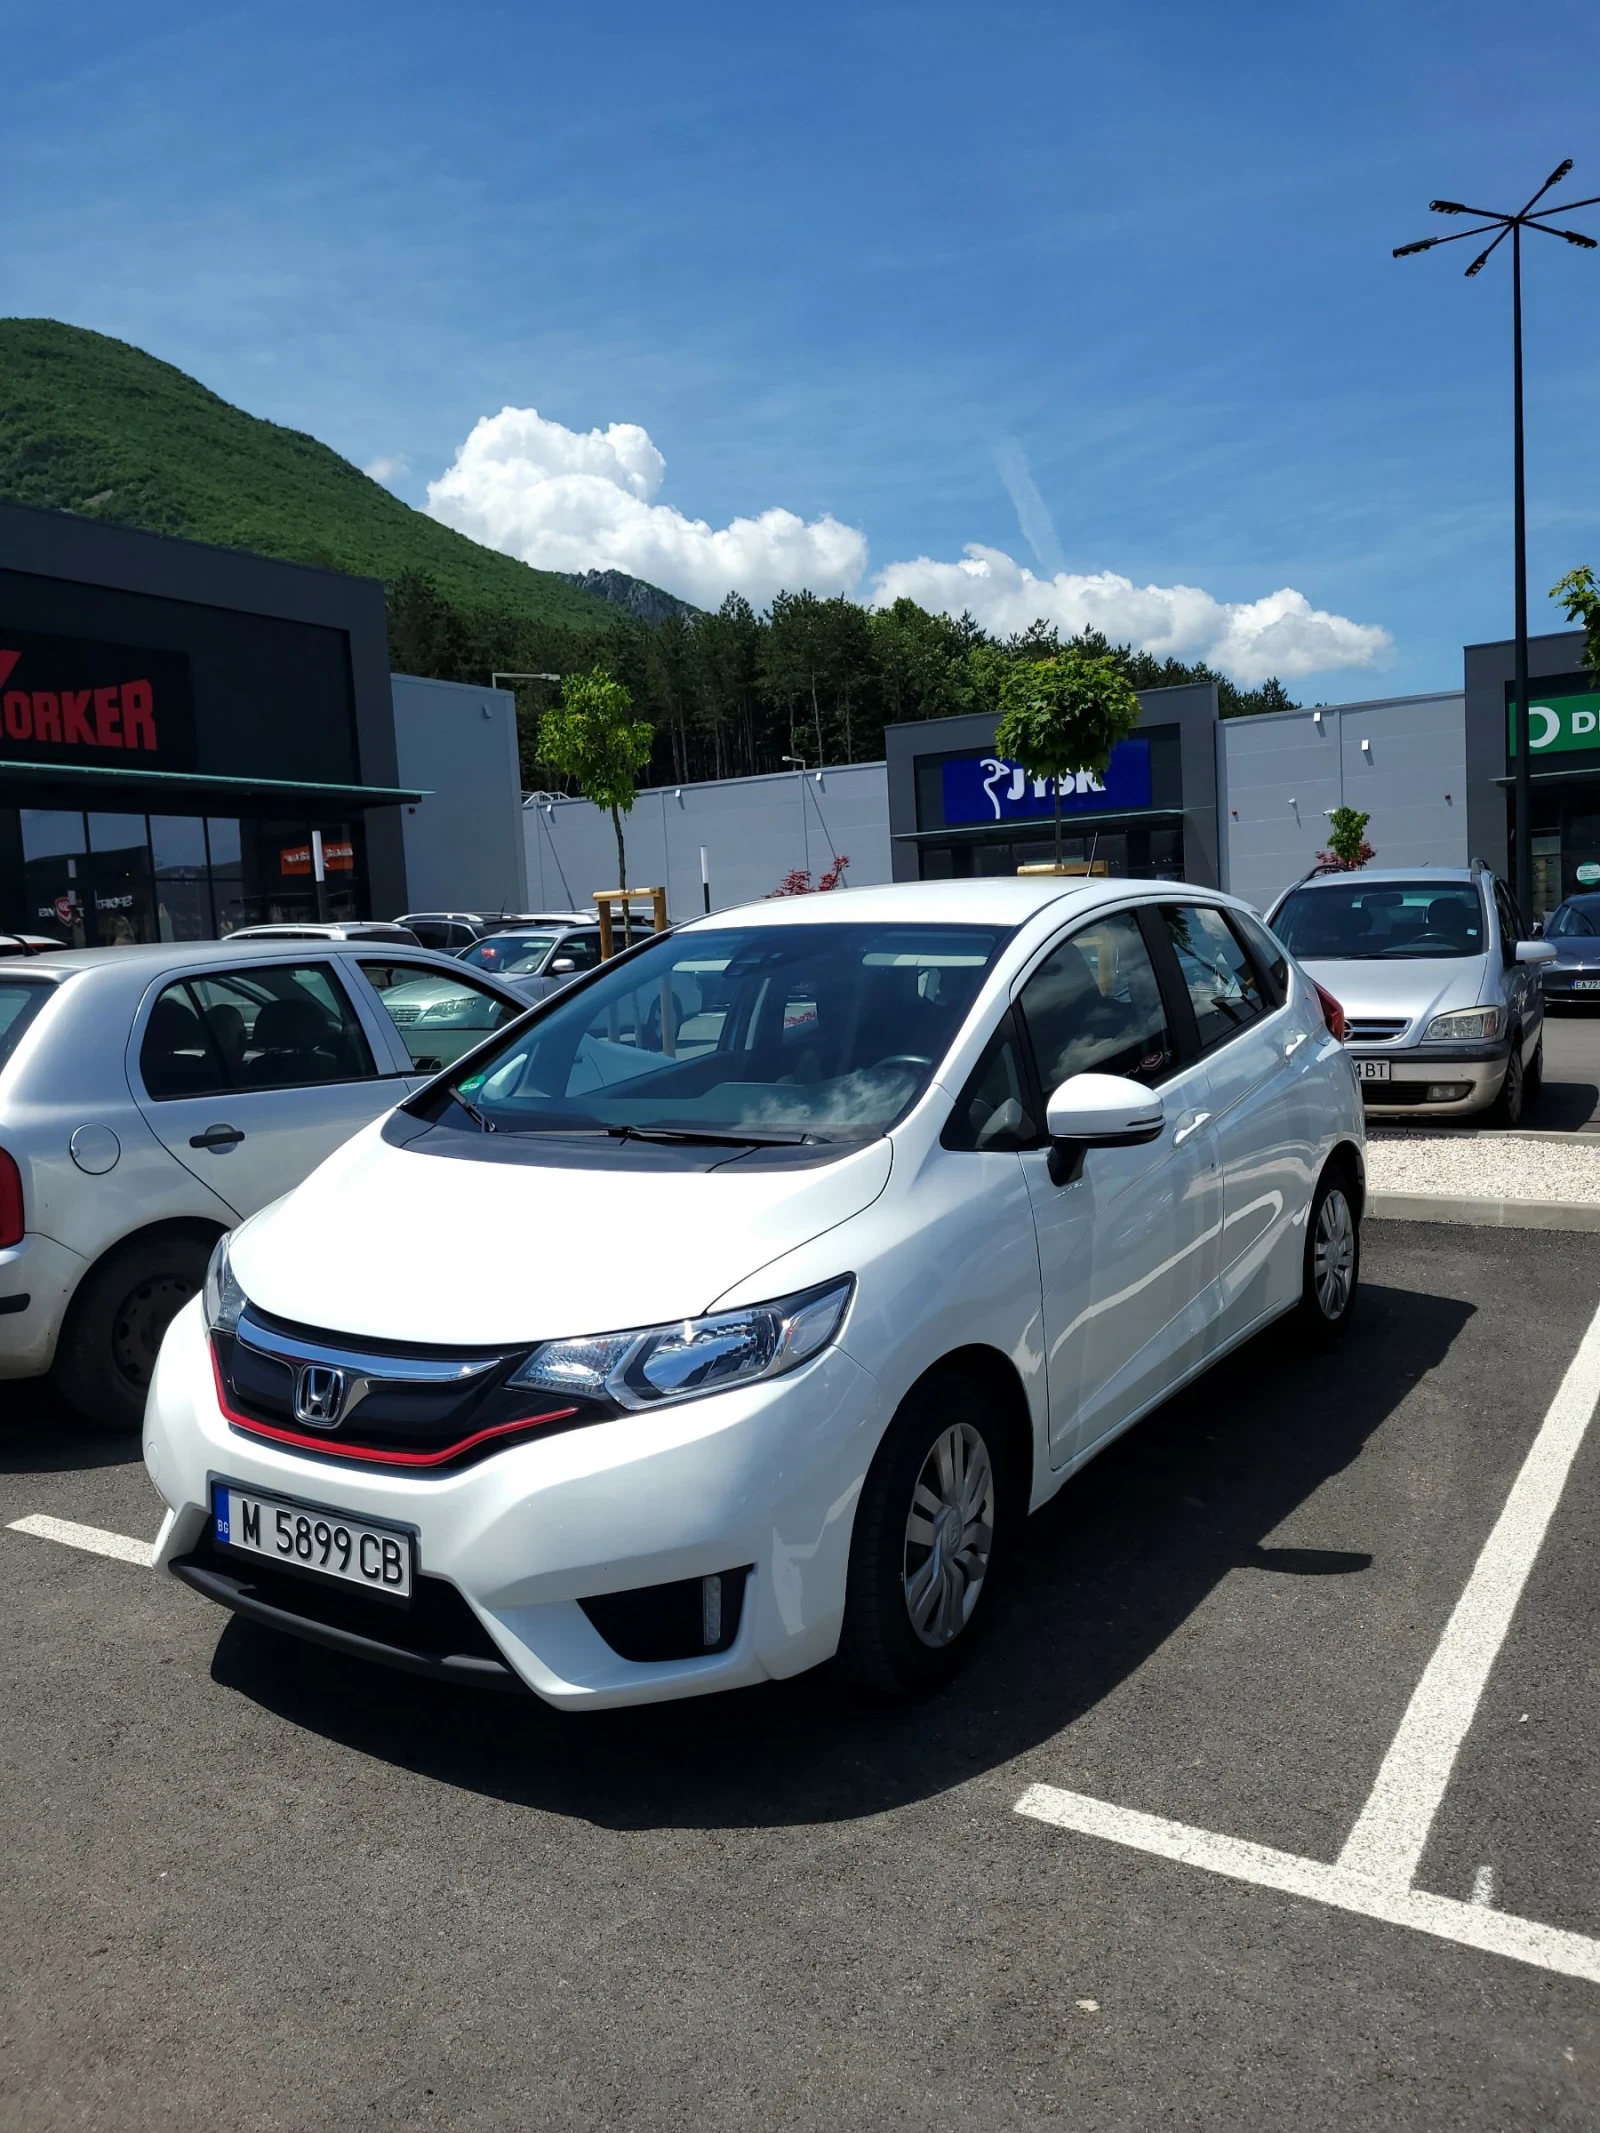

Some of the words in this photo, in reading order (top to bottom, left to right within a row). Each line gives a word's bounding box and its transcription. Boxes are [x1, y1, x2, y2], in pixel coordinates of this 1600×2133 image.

[0, 650, 157, 750] ORKER
[1571, 709, 1600, 735] D
[217, 1519, 229, 1534] BG
[242, 1499, 260, 1546] M
[276, 1509, 351, 1571] 5899
[360, 1533, 403, 1584] CB
